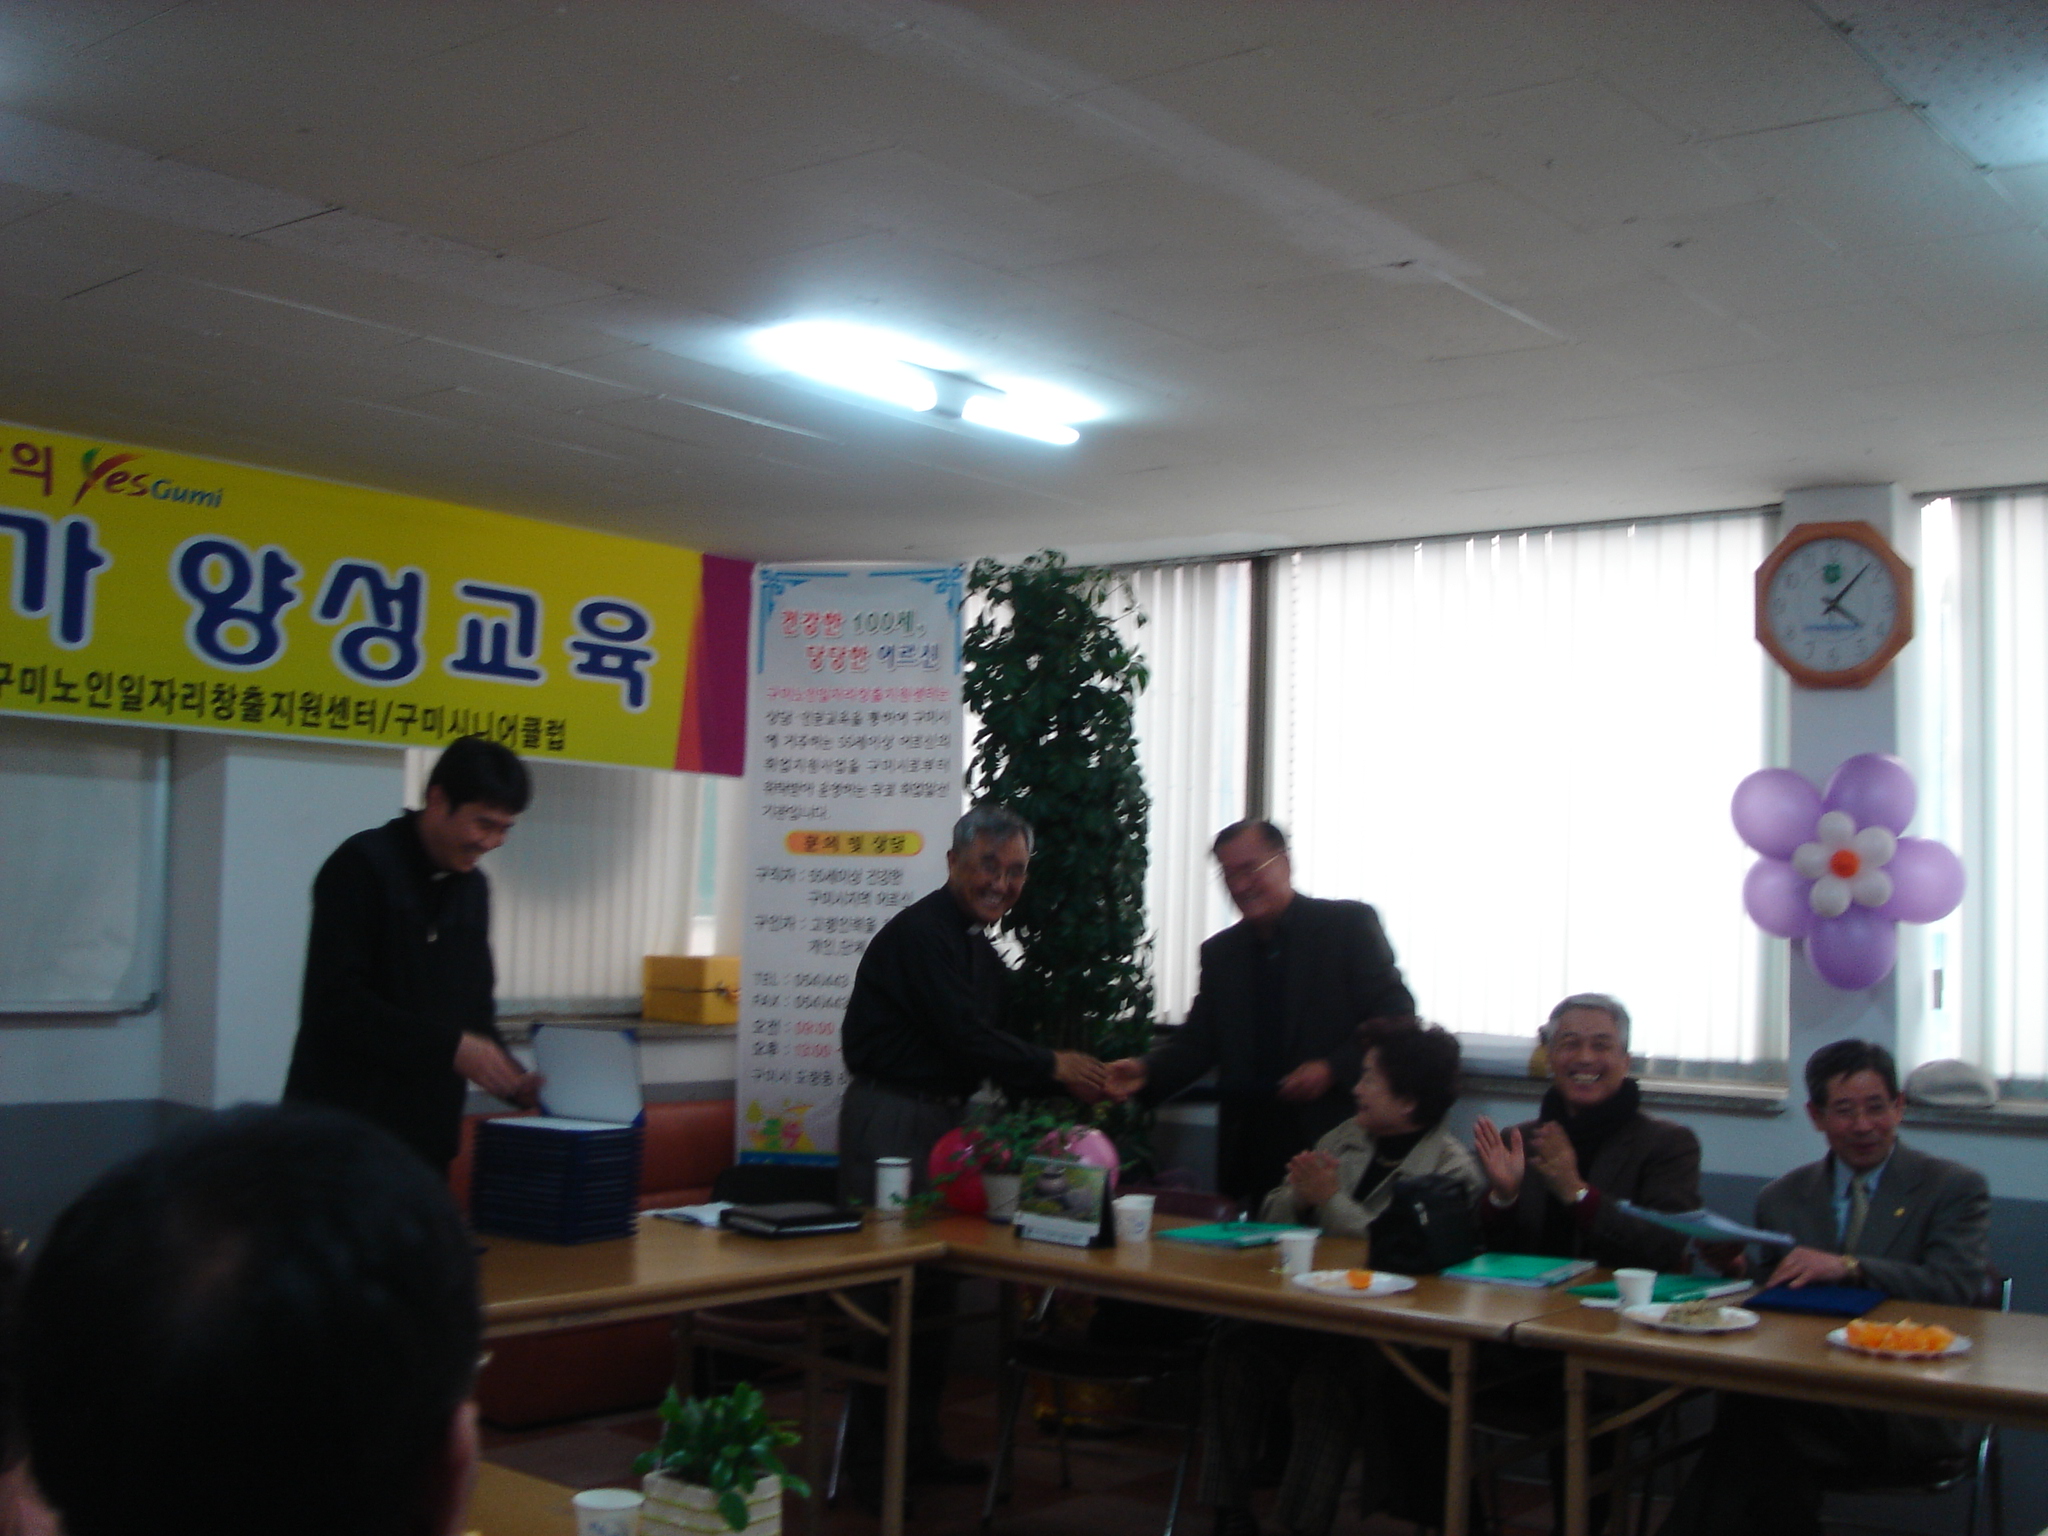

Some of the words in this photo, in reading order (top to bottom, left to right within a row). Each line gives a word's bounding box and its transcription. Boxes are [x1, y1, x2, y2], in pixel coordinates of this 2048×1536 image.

[0, 442, 53, 497] 의
[150, 478, 223, 508] Gumi
[178, 538, 655, 710] 양성교육
[782, 609, 844, 637] 건강한
[806, 644, 870, 673] 당당한
[876, 643, 940, 673] 어르신
[871, 833, 907, 854] 상담
